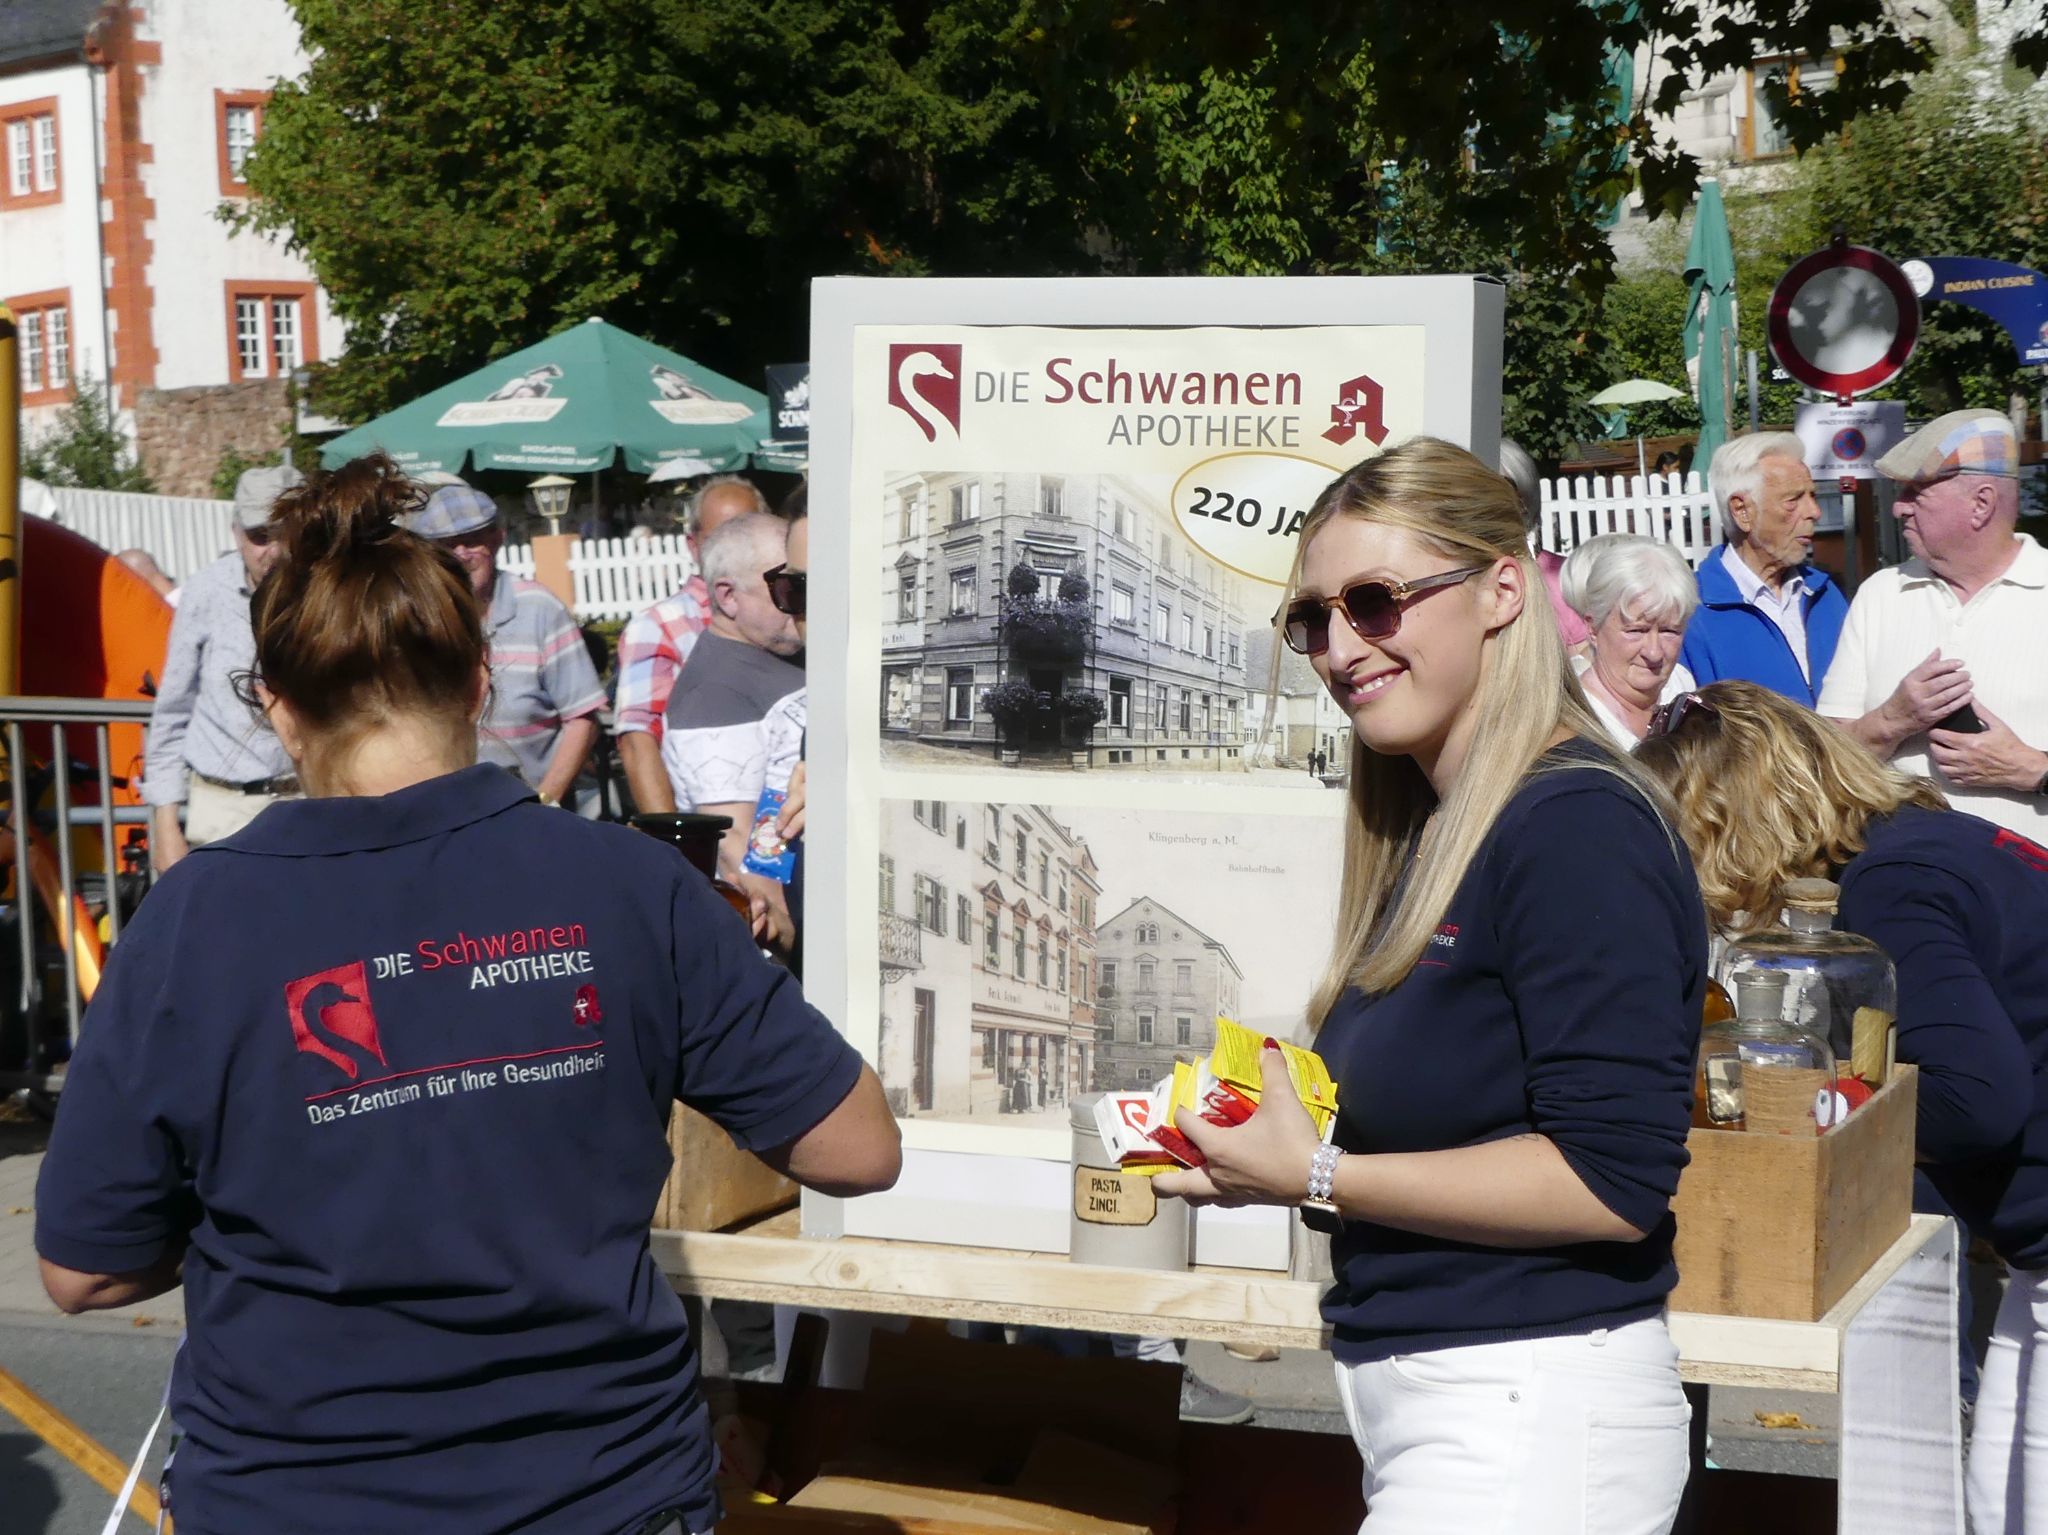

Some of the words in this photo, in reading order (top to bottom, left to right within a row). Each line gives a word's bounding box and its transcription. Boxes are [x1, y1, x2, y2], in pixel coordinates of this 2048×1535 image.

[1944, 279, 1986, 294] INDIAN
[1987, 275, 2034, 289] CUISINE
[974, 371, 1030, 403] DIE
[1044, 357, 1302, 406] Schwanen
[1107, 414, 1301, 448] APOTHEKE
[1189, 486, 1262, 528] 220
[1267, 506, 1307, 538] JA
[1147, 831, 1208, 847] Klingenberg
[373, 952, 415, 980] DIE
[417, 922, 587, 971] Schwanen
[469, 950, 595, 991] APOTHEKE
[307, 1101, 346, 1126] Das
[348, 1081, 422, 1117] Zentrum
[426, 1074, 458, 1099] für
[460, 1068, 498, 1093] Ihre
[503, 1050, 606, 1085] Gesundheit
[1090, 1177, 1122, 1194] PASTA
